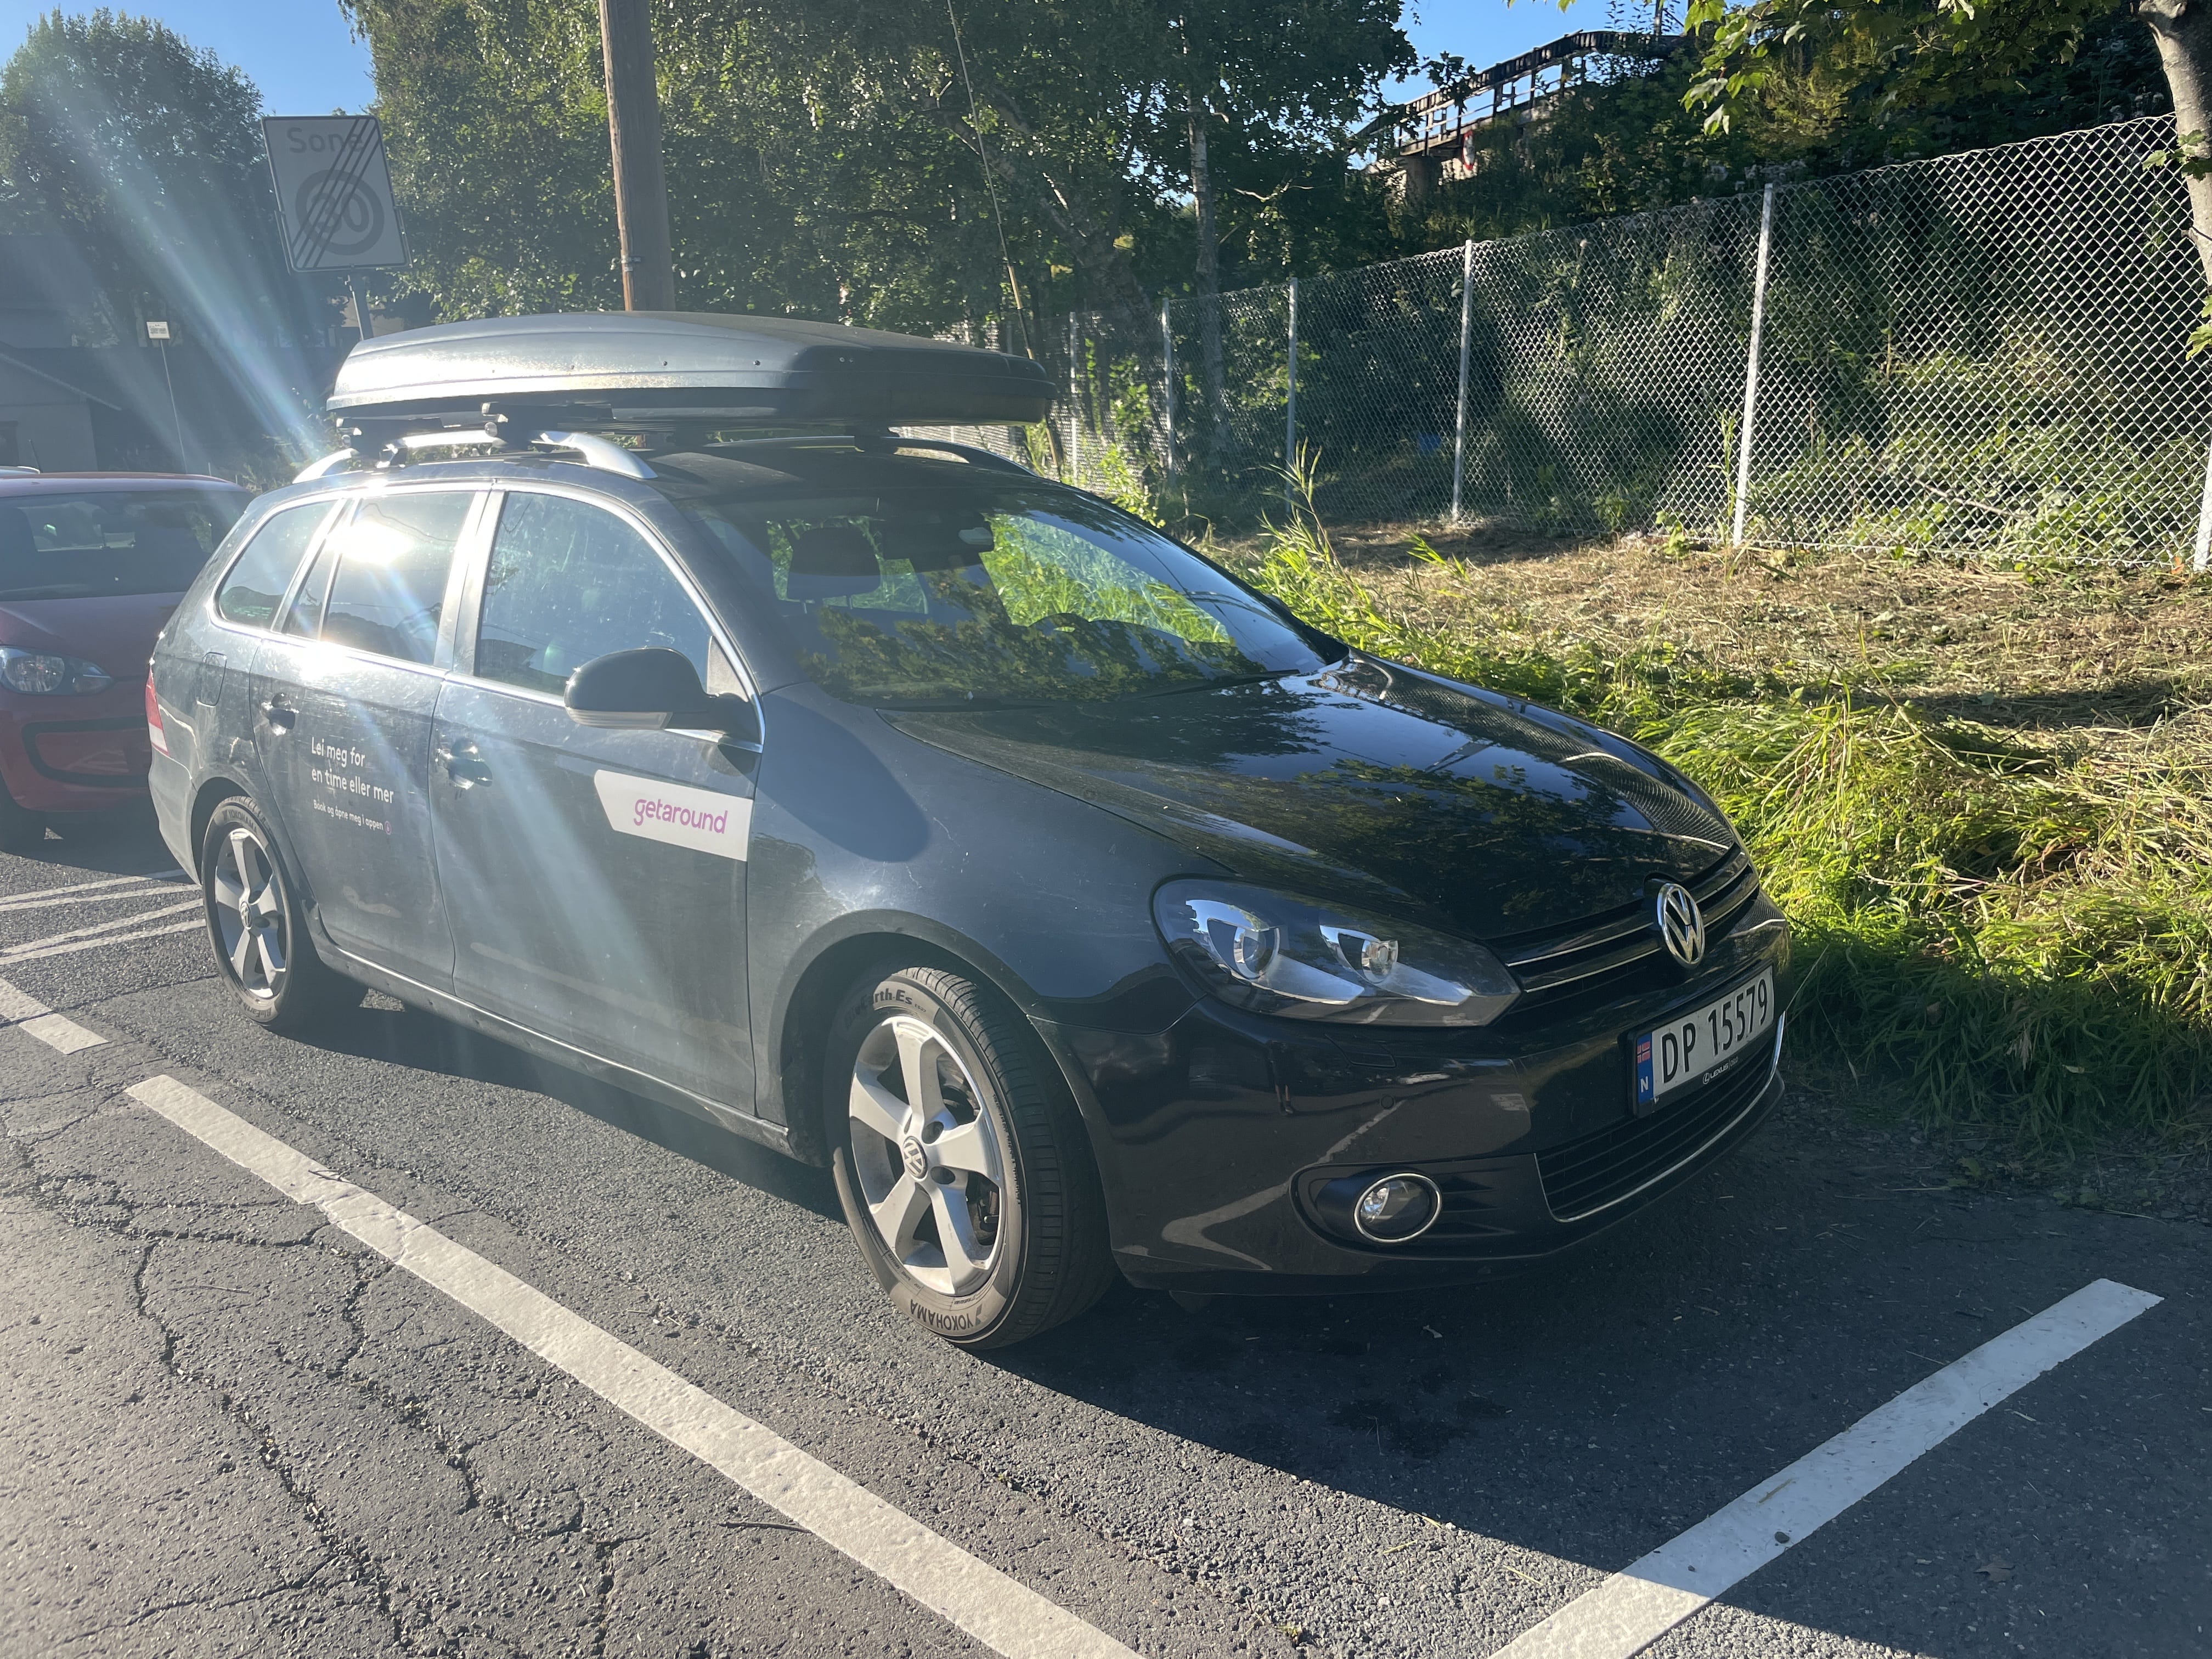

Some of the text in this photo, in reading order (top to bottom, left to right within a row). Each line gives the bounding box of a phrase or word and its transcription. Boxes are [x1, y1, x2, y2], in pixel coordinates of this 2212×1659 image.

[287, 127, 364, 153] Sone
[311, 193, 370, 233] 30
[311, 737, 365, 768] Lei meg for
[312, 768, 394, 803] en time eller mer
[313, 799, 326, 812] Book
[327, 806, 334, 817] og
[335, 805, 348, 819] åpne
[349, 813, 362, 826] meg
[365, 818, 383, 831] appen
[634, 799, 728, 834] getaround
[1661, 979, 1768, 1084] DP 15579
[1640, 1076, 1649, 1093] N
[1710, 1063, 1729, 1079] LEXUS
[910, 1299, 974, 1330] YOKOHAMA
